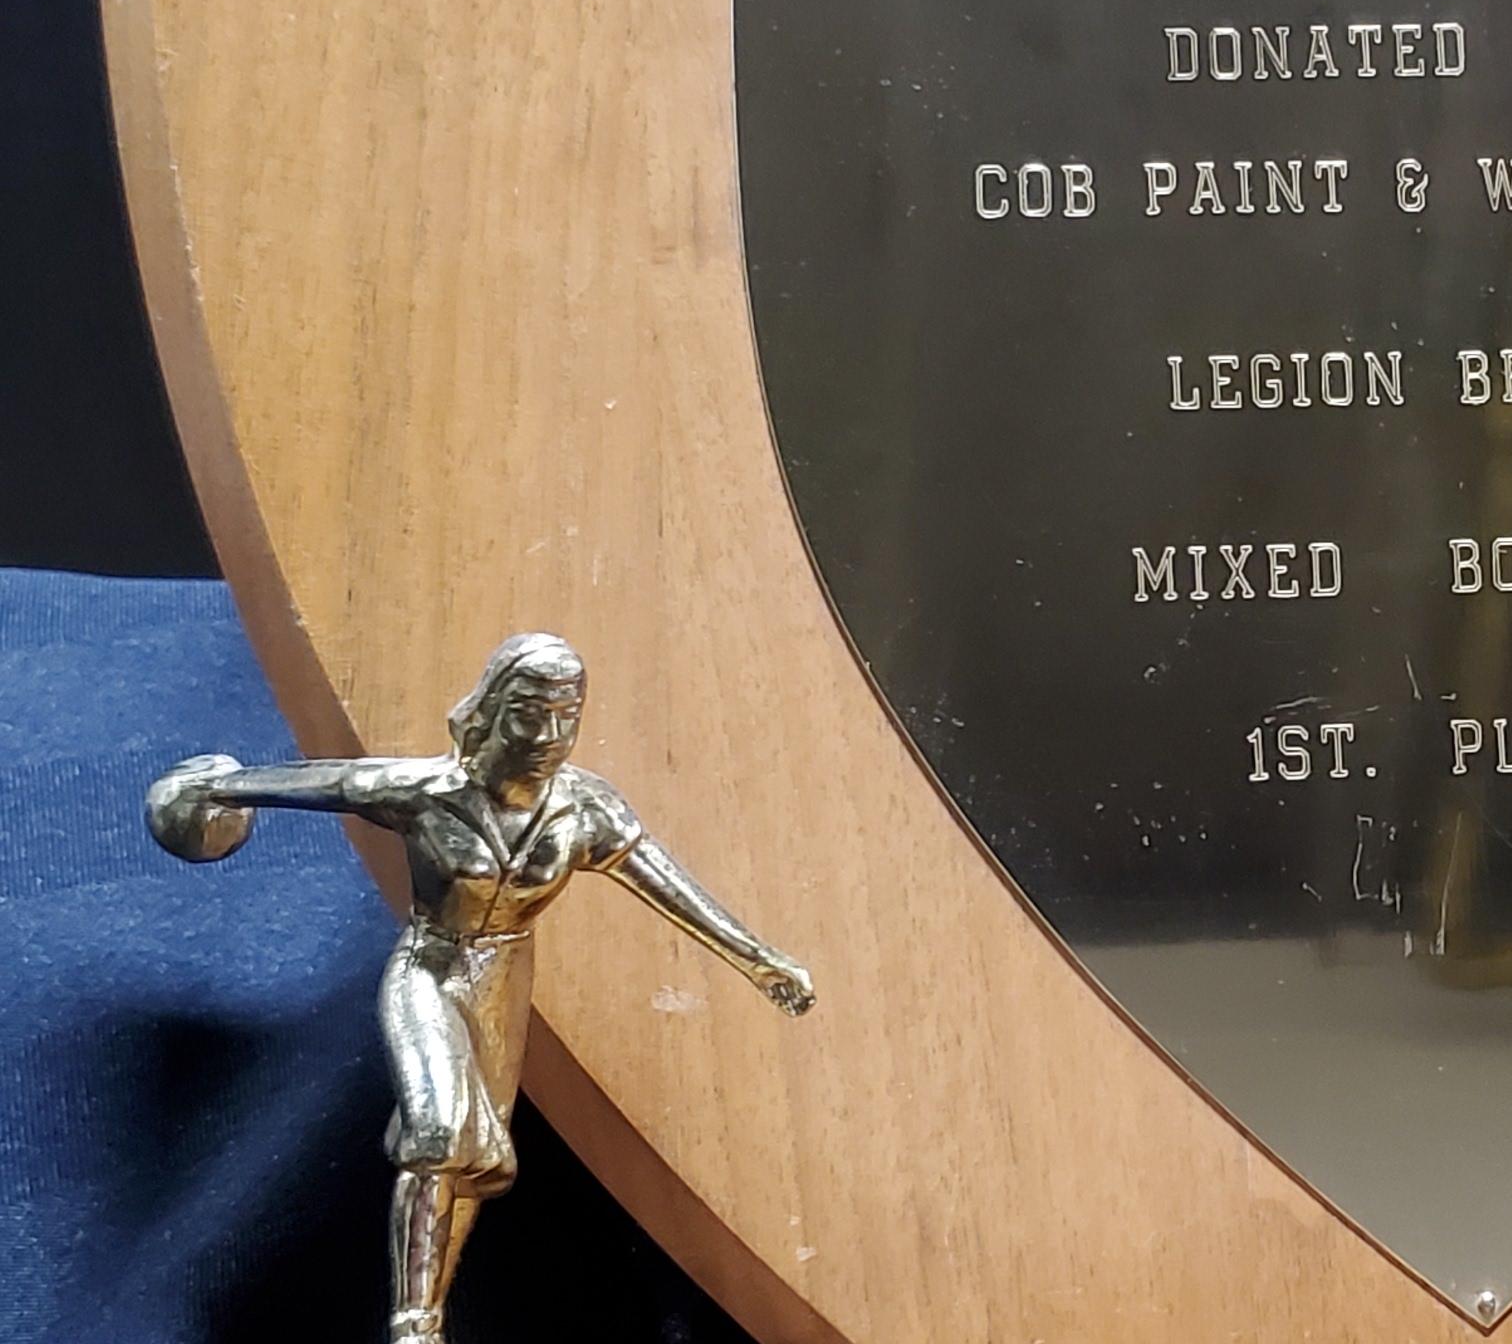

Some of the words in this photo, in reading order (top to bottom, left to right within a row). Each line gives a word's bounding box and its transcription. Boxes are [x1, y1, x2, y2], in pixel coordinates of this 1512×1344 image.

[1164, 22, 1468, 82] DONATED
[974, 162, 1097, 219] COB
[1143, 158, 1349, 217] PAINT
[1396, 157, 1428, 213] &
[1167, 350, 1405, 412] LEGION
[1131, 541, 1344, 603] MIXED
[1245, 723, 1378, 781] 1ST.
